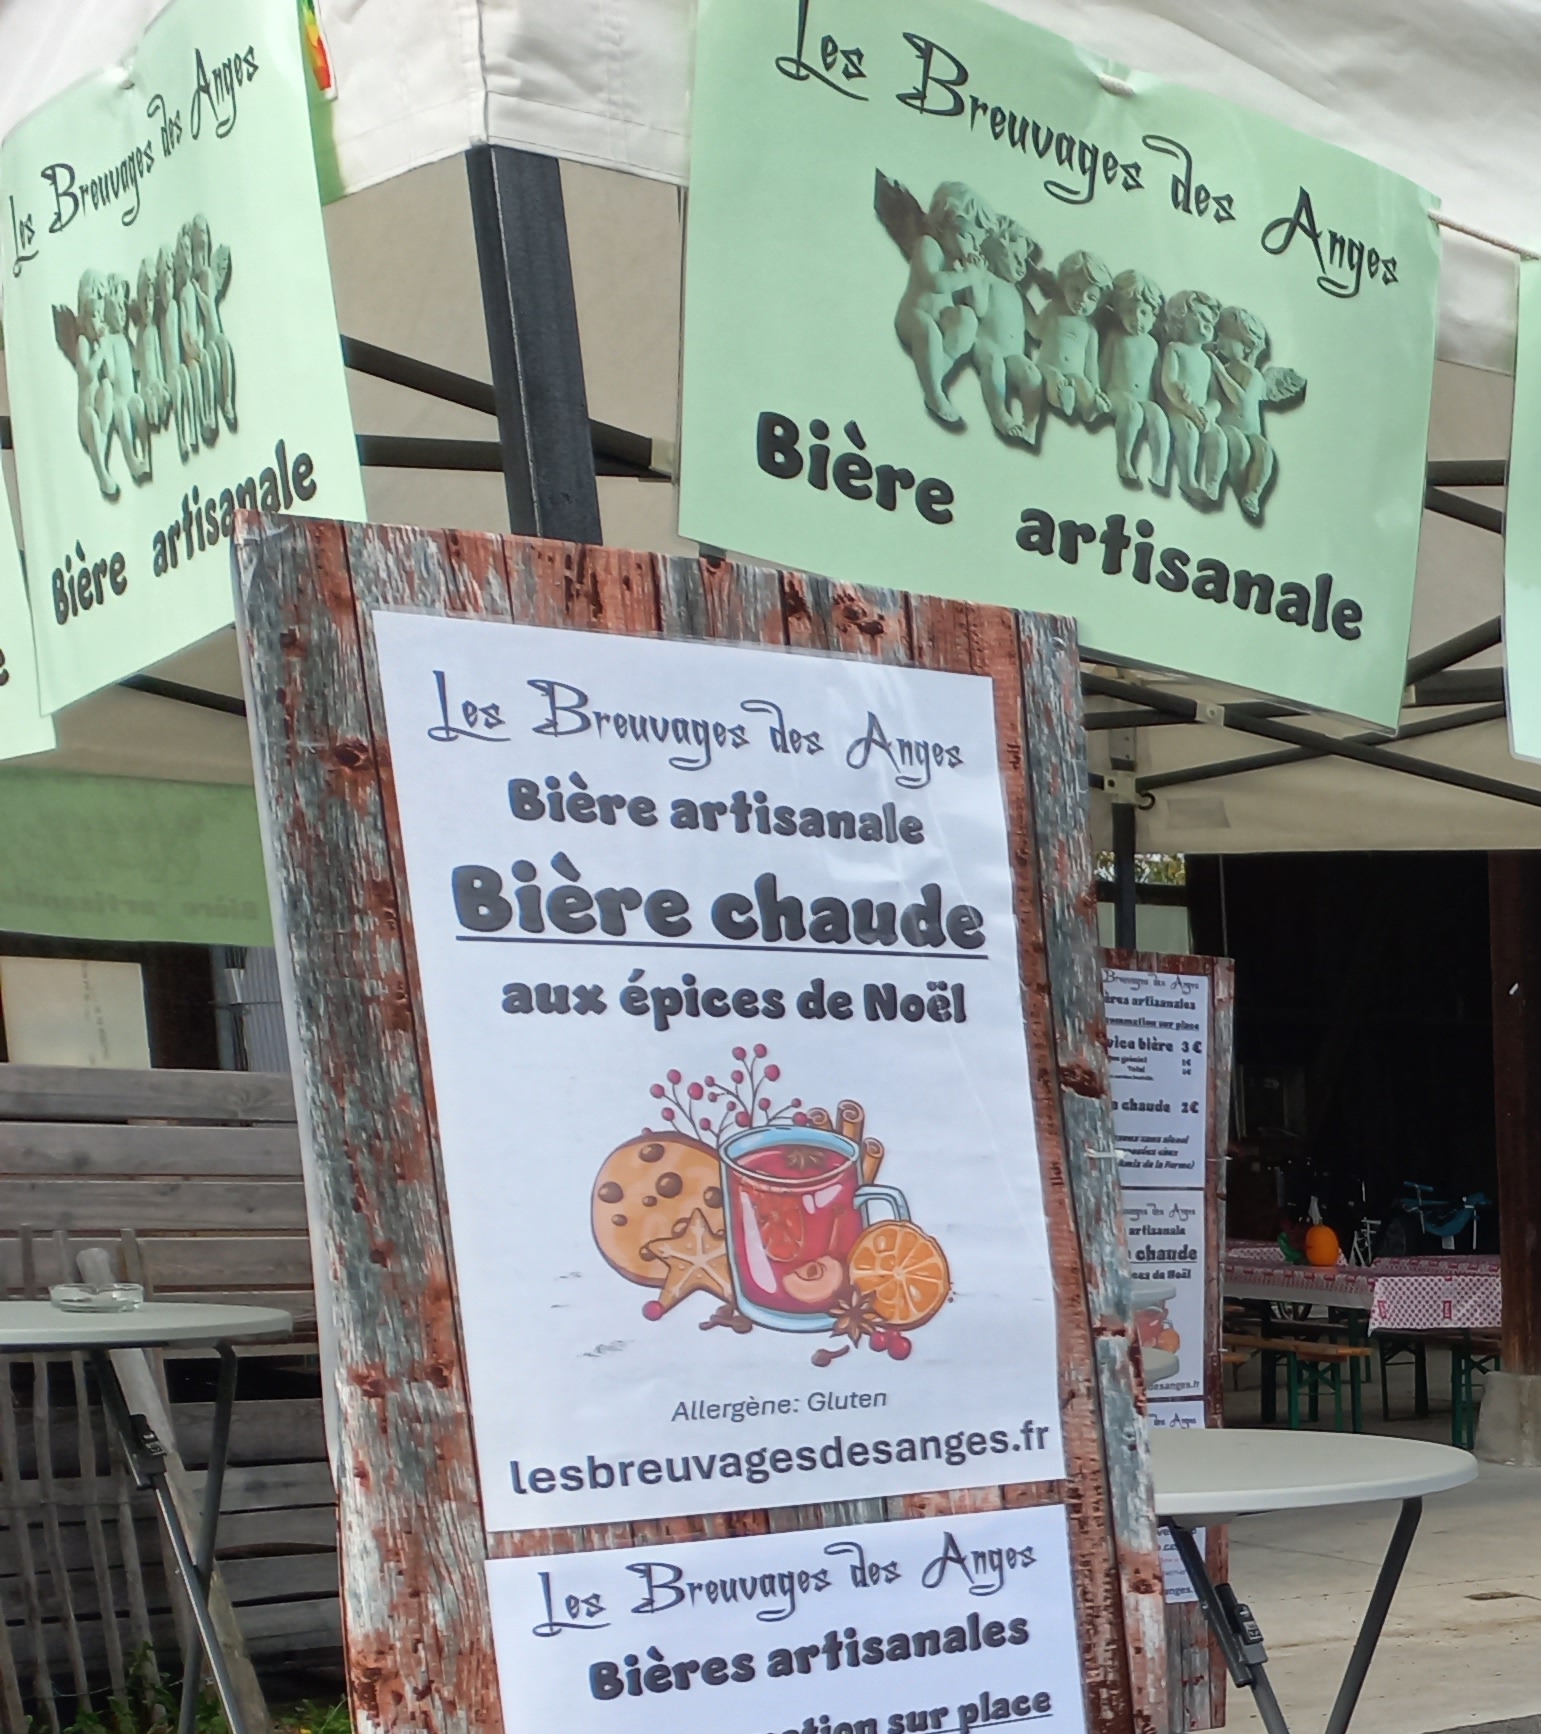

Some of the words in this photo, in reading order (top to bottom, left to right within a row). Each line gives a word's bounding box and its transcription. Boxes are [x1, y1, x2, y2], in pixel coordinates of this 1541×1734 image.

[8, 195, 39, 278] Les
[41, 145, 155, 234] Breuvages
[148, 94, 182, 159] des
[191, 45, 258, 139] Anges
[774, 0, 869, 101] Les
[896, 31, 1144, 205] Breuvages
[1141, 134, 1235, 224] des
[1260, 186, 1399, 298] Anges
[52, 541, 127, 625] Bière
[153, 439, 317, 577] artisanale
[756, 411, 955, 525] Bière
[1015, 508, 1362, 641] artisanale
[427, 670, 511, 743] Les
[528, 678, 749, 771] Breuvages
[740, 699, 823, 755] des
[846, 711, 964, 789] Anges
[508, 770, 658, 828] Bière
[670, 790, 925, 846] artisanale
[452, 851, 692, 936] Bière
[711, 873, 986, 950] chaude
[501, 980, 606, 1016] aux
[620, 968, 786, 1032] épices
[796, 978, 854, 1022] de
[863, 980, 967, 1024] Noël
[671, 1394, 800, 1423] Allergène:
[808, 1388, 887, 1414] Gluten
[509, 1419, 1050, 1496] lesbreuvagesdesanges.fr
[589, 1647, 755, 1701] Bières
[766, 1612, 1029, 1679] artisanales
